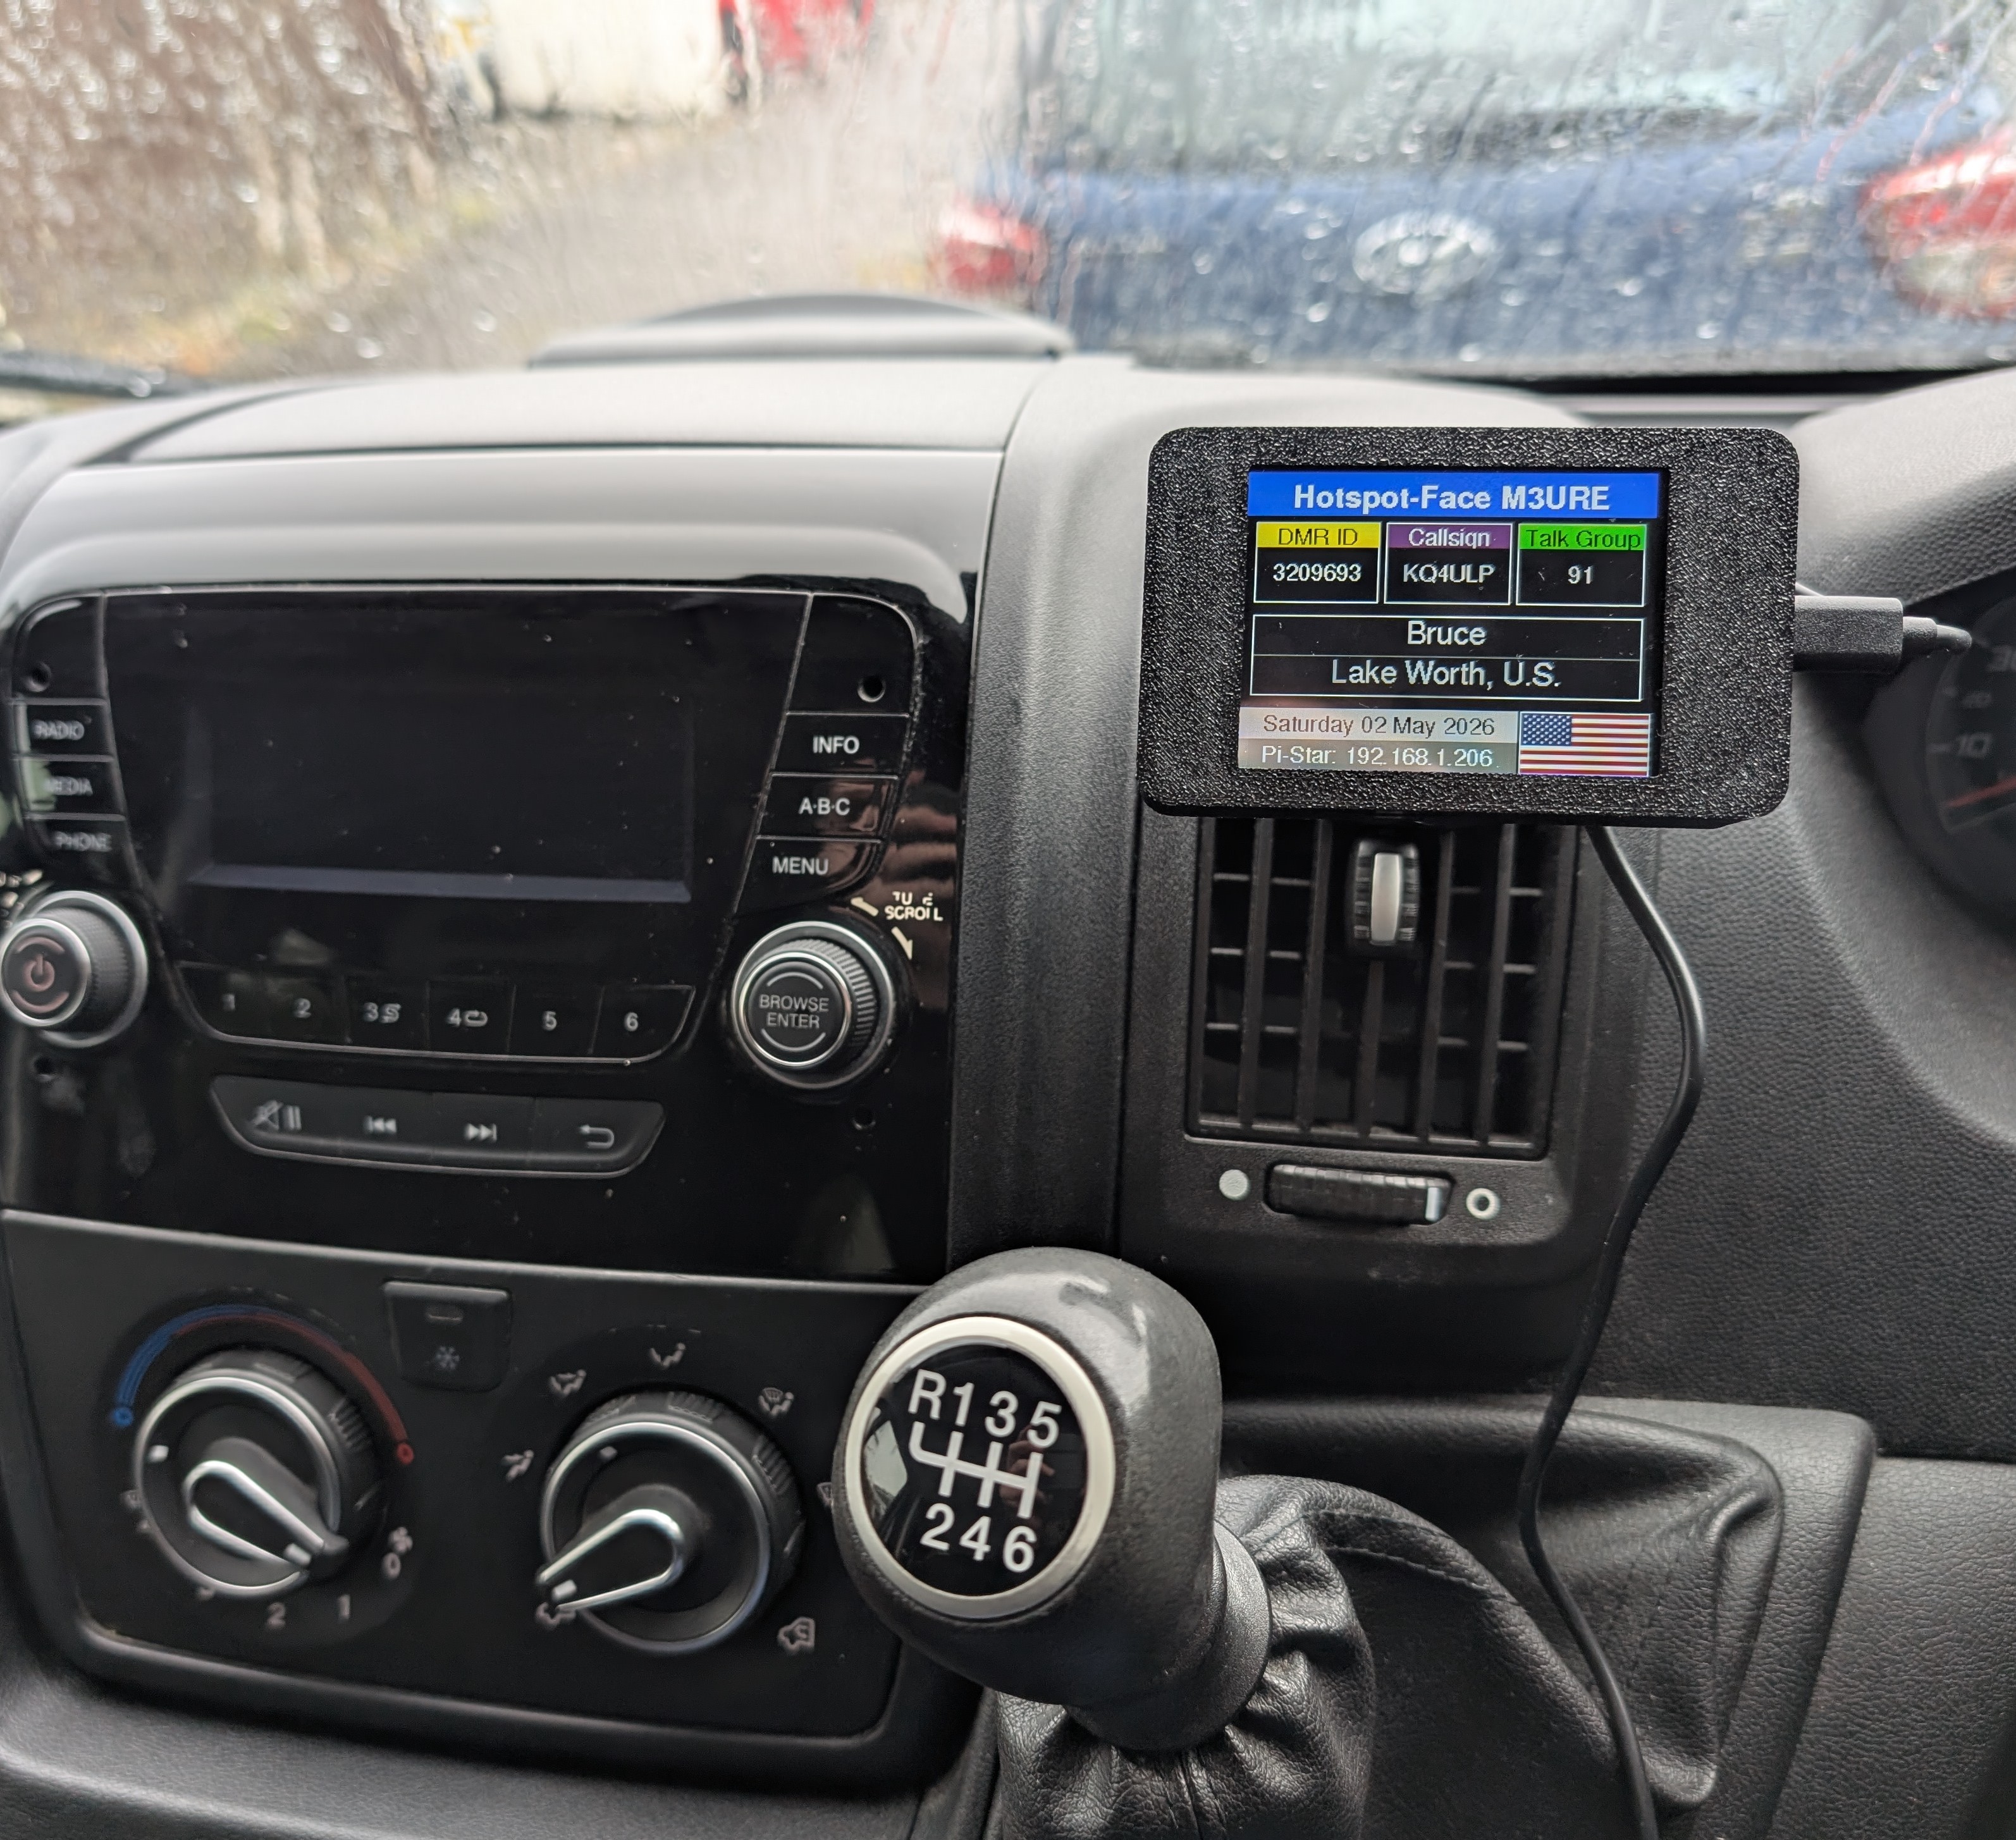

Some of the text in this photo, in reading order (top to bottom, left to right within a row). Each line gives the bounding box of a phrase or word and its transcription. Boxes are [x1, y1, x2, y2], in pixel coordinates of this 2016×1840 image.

[1294, 484, 1609, 514] Hotspot-Face M3URE
[1278, 528, 1358, 546] DMR ID
[1525, 530, 1641, 549] Talk Group
[1273, 563, 1361, 582] 3209693
[1403, 563, 1494, 583] KQ4ULP
[1568, 566, 1594, 584] 91
[1407, 620, 1487, 646] Bruce
[1332, 659, 1561, 690] Lake Worth, U.S.
[32, 720, 85, 740] RADIO
[1263, 715, 1495, 738] Saturday 02 May 2026
[813, 736, 859, 754] INFO
[1262, 745, 1493, 767] Pi-Star: 192.168.1.206
[54, 831, 112, 852] PHONE
[772, 856, 829, 876] MENU
[223, 993, 236, 1012] 1
[294, 997, 312, 1019] 2
[759, 995, 830, 1012] BROWSE
[544, 1012, 557, 1029] 5
[623, 1012, 639, 1030] 6
[766, 1013, 820, 1029] ENTER
[266, 1602, 286, 1630] 2
